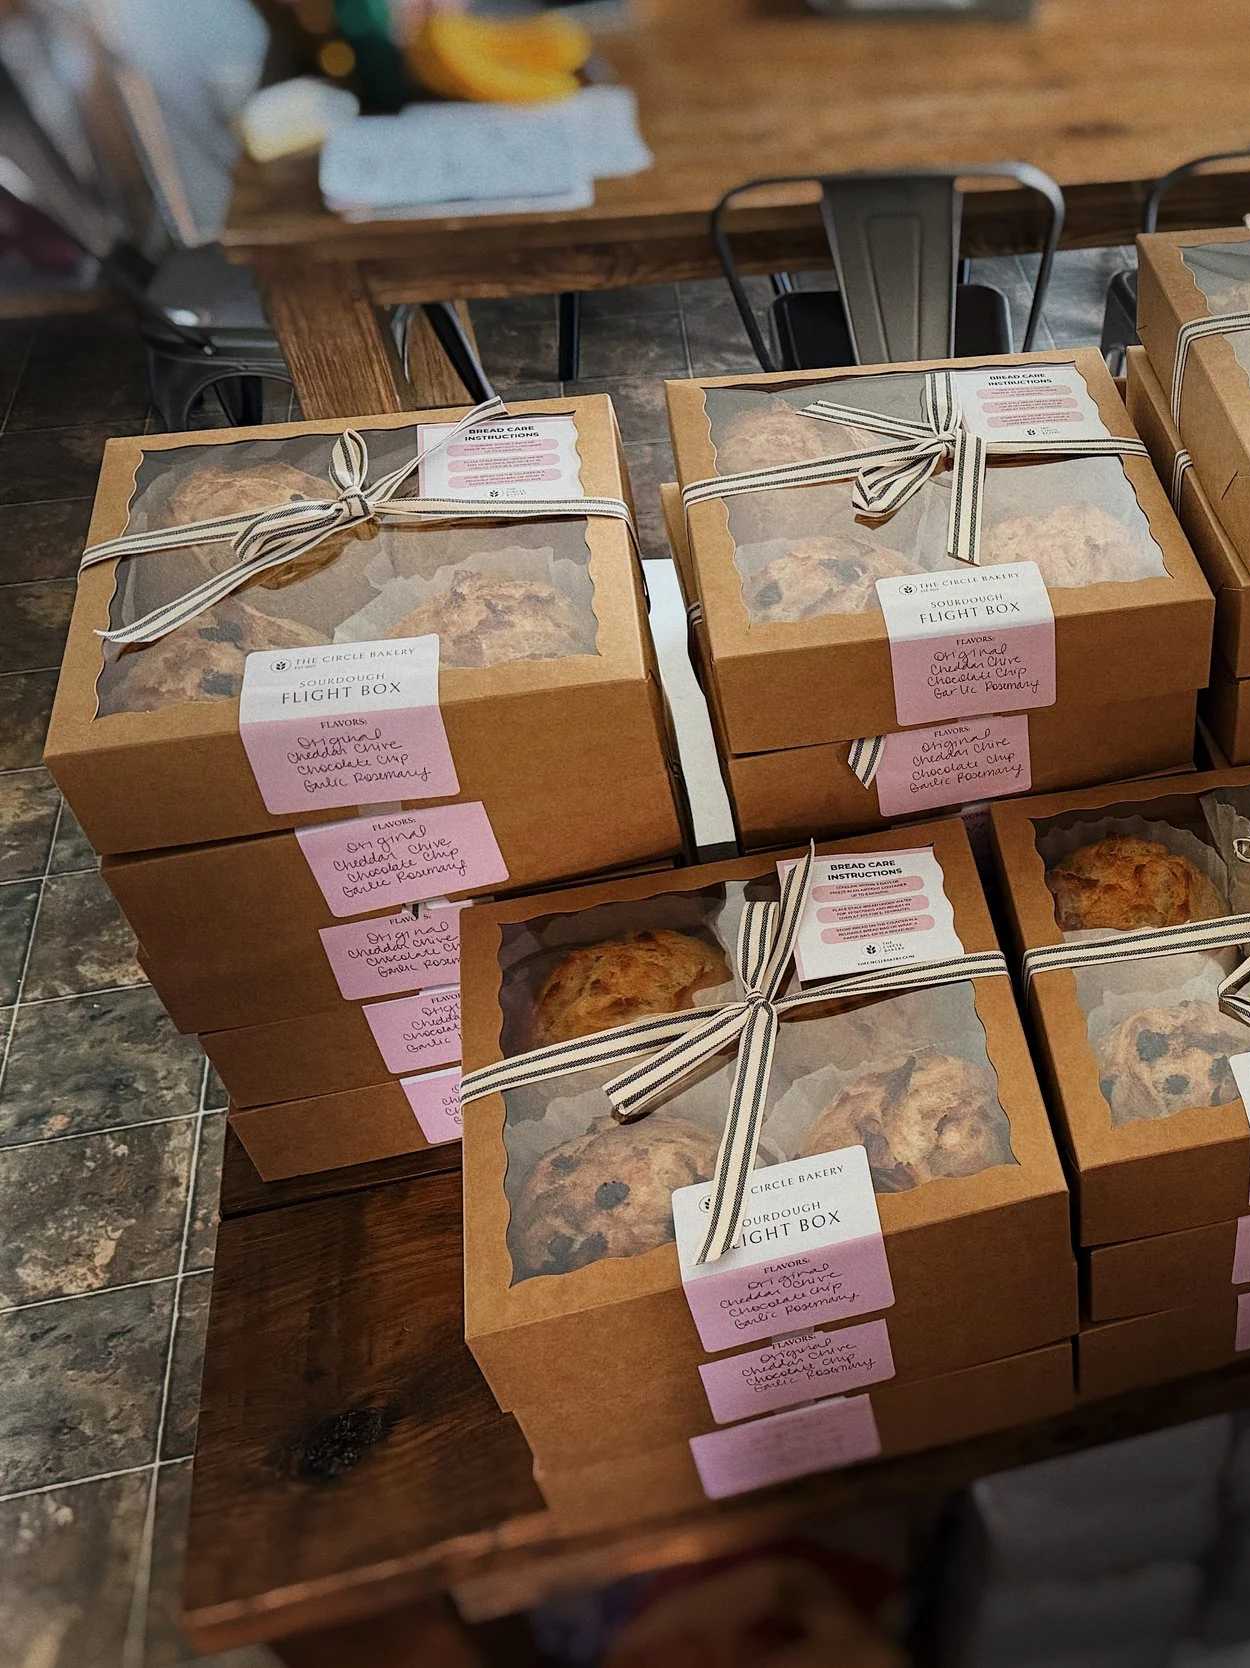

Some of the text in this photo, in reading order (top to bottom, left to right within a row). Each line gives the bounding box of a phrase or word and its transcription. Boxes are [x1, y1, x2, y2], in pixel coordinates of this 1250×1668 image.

[464, 432, 539, 441] INSTRUCTIONS
[943, 578, 979, 587] CIRCLE
[982, 572, 1020, 582] BAKERY
[931, 594, 1003, 608] SOURDOUGH
[920, 602, 1021, 624] FLIGHT BOX
[956, 636, 994, 645] FLAVORS:
[295, 648, 416, 665] THE CIRCLE BAKERY
[934, 643, 1007, 663] Original
[930, 655, 1021, 676] Cheddar Chive
[299, 673, 385, 688] SOURDOUGH
[927, 667, 1027, 687] Chocolate Chip
[282, 682, 401, 704] FLIGHT BOX
[934, 679, 1040, 699] Garlic Rosemary
[320, 719, 368, 729] FLAVORS:
[934, 726, 971, 738] FLAVORS:
[297, 728, 382, 749] Original
[922, 729, 990, 753] Original
[287, 740, 402, 764] Cheddar Chive
[913, 737, 1011, 767] Cheddar Chive
[297, 753, 409, 775] Chocolate Chip
[912, 752, 1015, 781] Chocolate Chip
[304, 767, 431, 793] Garlic Rosemary
[910, 764, 1024, 793] Garlic Rosemary
[372, 817, 416, 832] FLAVORS:
[347, 824, 426, 854] Original
[333, 838, 452, 872] Cheddar Chive
[347, 847, 459, 883] Chocolate Chip
[827, 868, 902, 881] INSTRUCTIONS
[830, 862, 865, 871] BREAD
[343, 860, 467, 898] Garlic Rosemary
[750, 1165, 845, 1194] CIRCLE BAKERY
[742, 1201, 821, 1228] OURDOUGH
[733, 1210, 841, 1250] IGHT BOX
[747, 1263, 830, 1291] Original
[763, 1258, 811, 1274] FLAVORS:
[720, 1272, 843, 1309] Cheddar Chive
[728, 1292, 807, 1318] Chocolate
[734, 1293, 860, 1330] Garlic Rosemary
[760, 1338, 832, 1364] Original
[772, 1335, 816, 1350] FLAVORS:
[742, 1344, 857, 1377] Cheddar Chive
[746, 1363, 815, 1386] Chocolate
[754, 1358, 876, 1393] Garlic Rosemary
